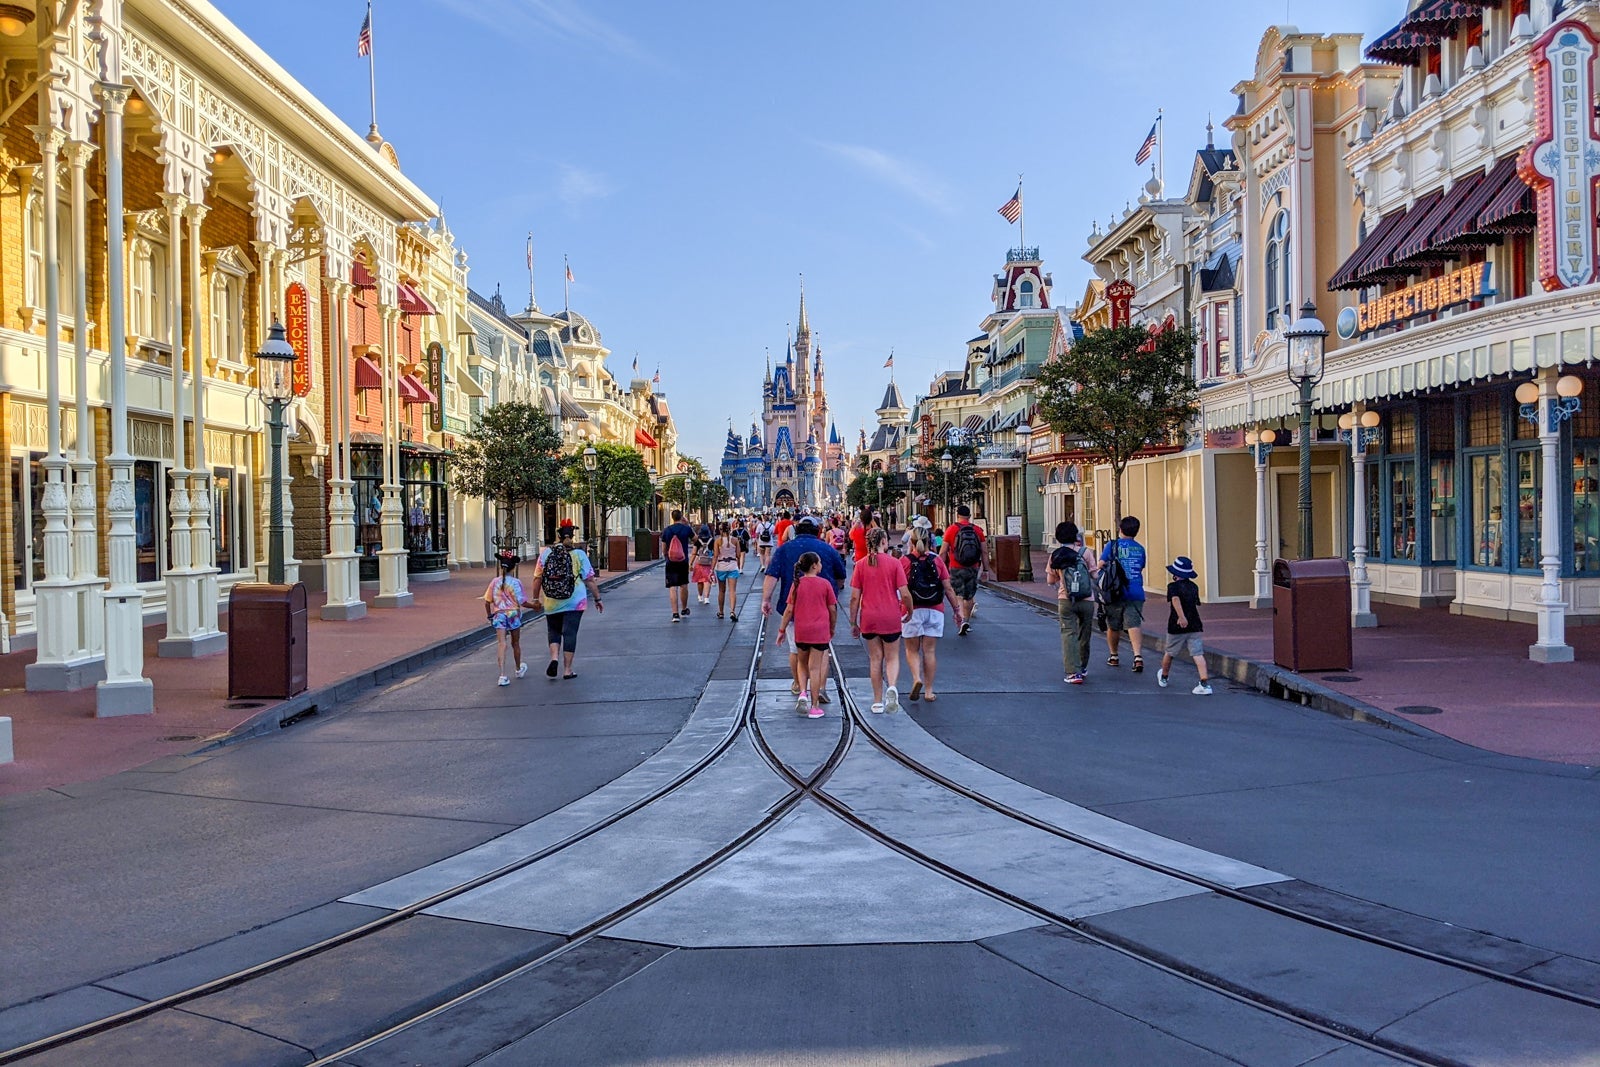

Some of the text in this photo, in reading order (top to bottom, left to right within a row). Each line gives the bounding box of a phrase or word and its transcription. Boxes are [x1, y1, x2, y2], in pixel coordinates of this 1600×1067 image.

[1561, 51, 1584, 273] CONFECTIONERY
[289, 294, 305, 384] EMPORIUM
[1358, 263, 1484, 332] CONFECTIONERY
